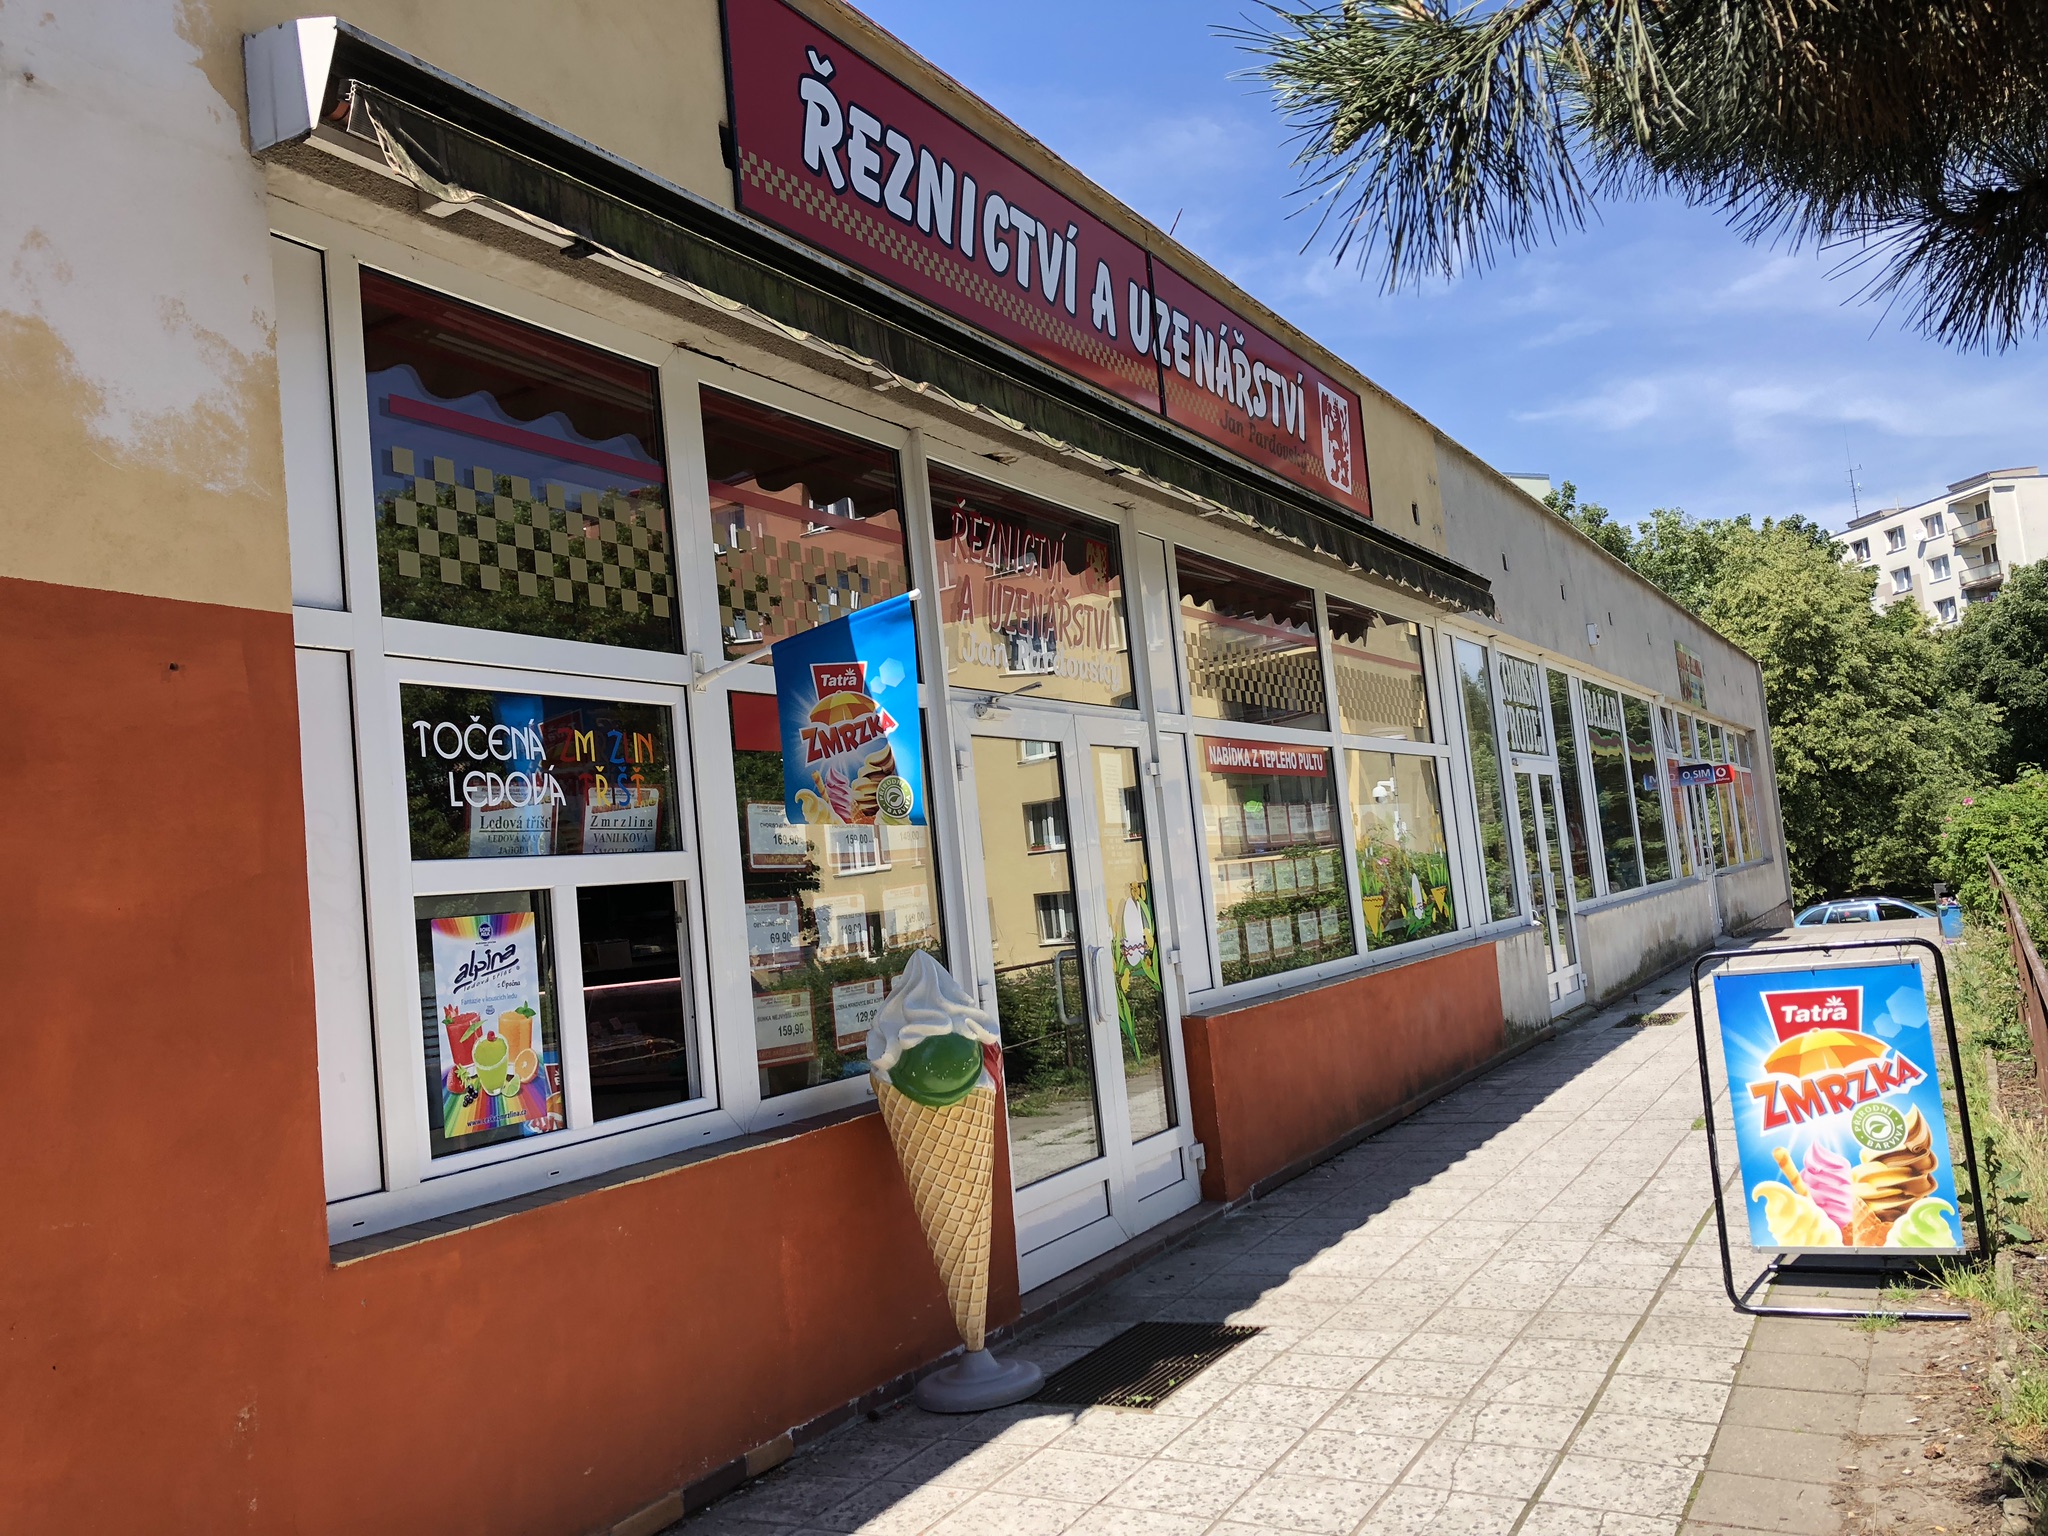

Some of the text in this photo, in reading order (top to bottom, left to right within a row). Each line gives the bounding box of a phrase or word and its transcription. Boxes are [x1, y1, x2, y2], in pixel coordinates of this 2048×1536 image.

[799, 45, 1308, 442] ŘEZNICTVÍ A UZENÁŘSTVÍ
[1220, 409, 1245, 438] Jan
[950, 497, 1067, 584] ŘEZNICTVÍ
[957, 574, 1112, 651] A UZENÁŘSTVÍ
[962, 631, 1121, 692] Jan Pardovský
[820, 672, 858, 688] Tatra
[411, 715, 547, 761] TOČENÁ
[800, 711, 897, 765] ZMRZKA
[1208, 742, 1324, 771] NABÍDKA Z TEPLÉHO PULTU
[1693, 768, 1711, 779] SIM
[448, 764, 567, 808] LEDOVÁ
[479, 815, 523, 830] Ledová
[590, 815, 654, 828] Zmrzlina
[453, 943, 517, 985] alpina
[777, 1022, 805, 1037] 159,90
[1780, 1002, 1848, 1024] Tatra
[1751, 1054, 1922, 1131] ZMRZKA
[1866, 1123, 1904, 1150] BARVIVA
